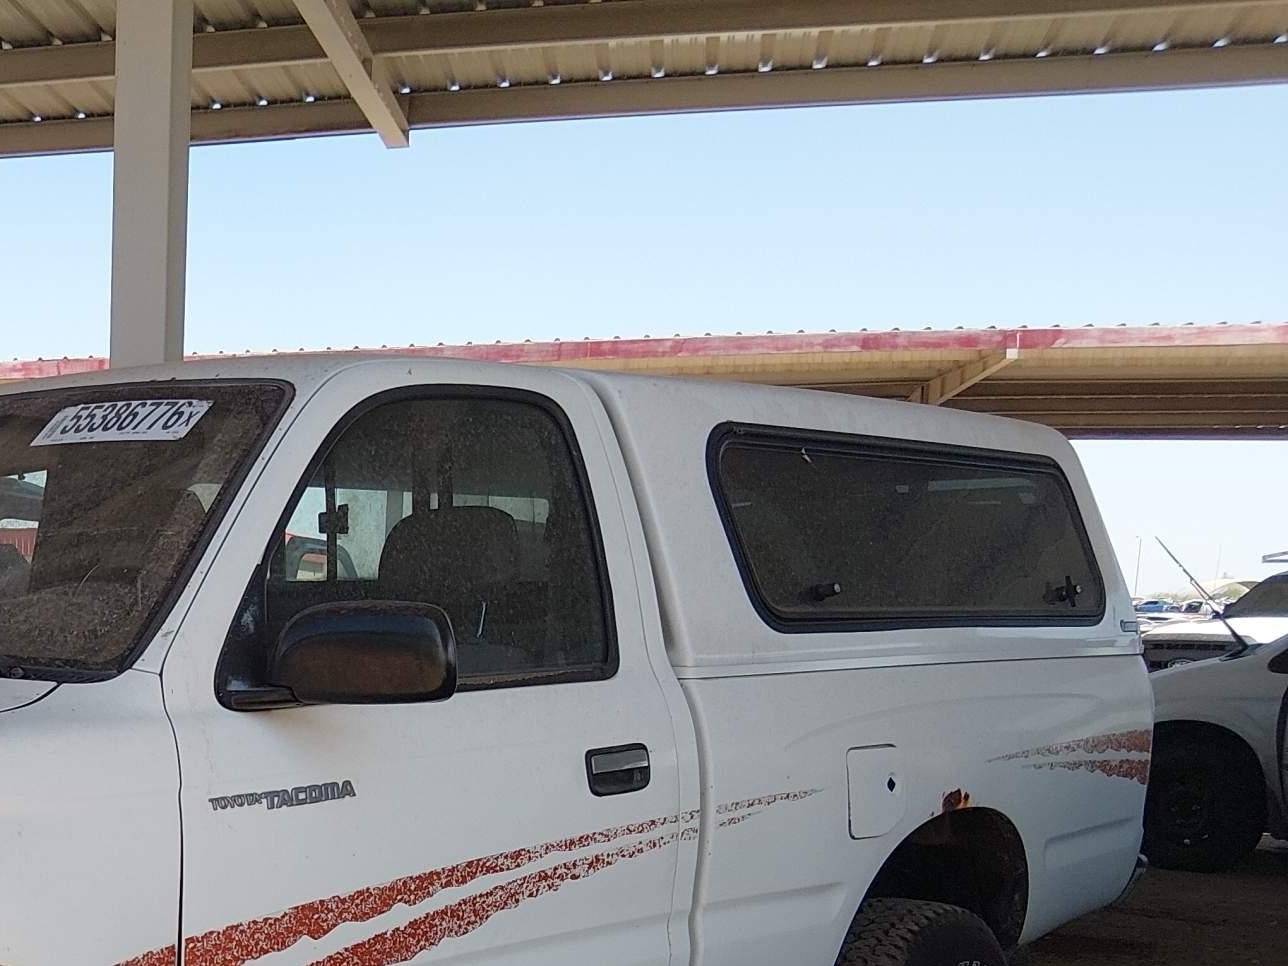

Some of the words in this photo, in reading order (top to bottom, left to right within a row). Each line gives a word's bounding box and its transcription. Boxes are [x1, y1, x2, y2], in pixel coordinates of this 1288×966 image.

[61, 401, 193, 435] 55386776
[208, 792, 264, 811] TOYOTA
[261, 779, 357, 810] TACOMA
